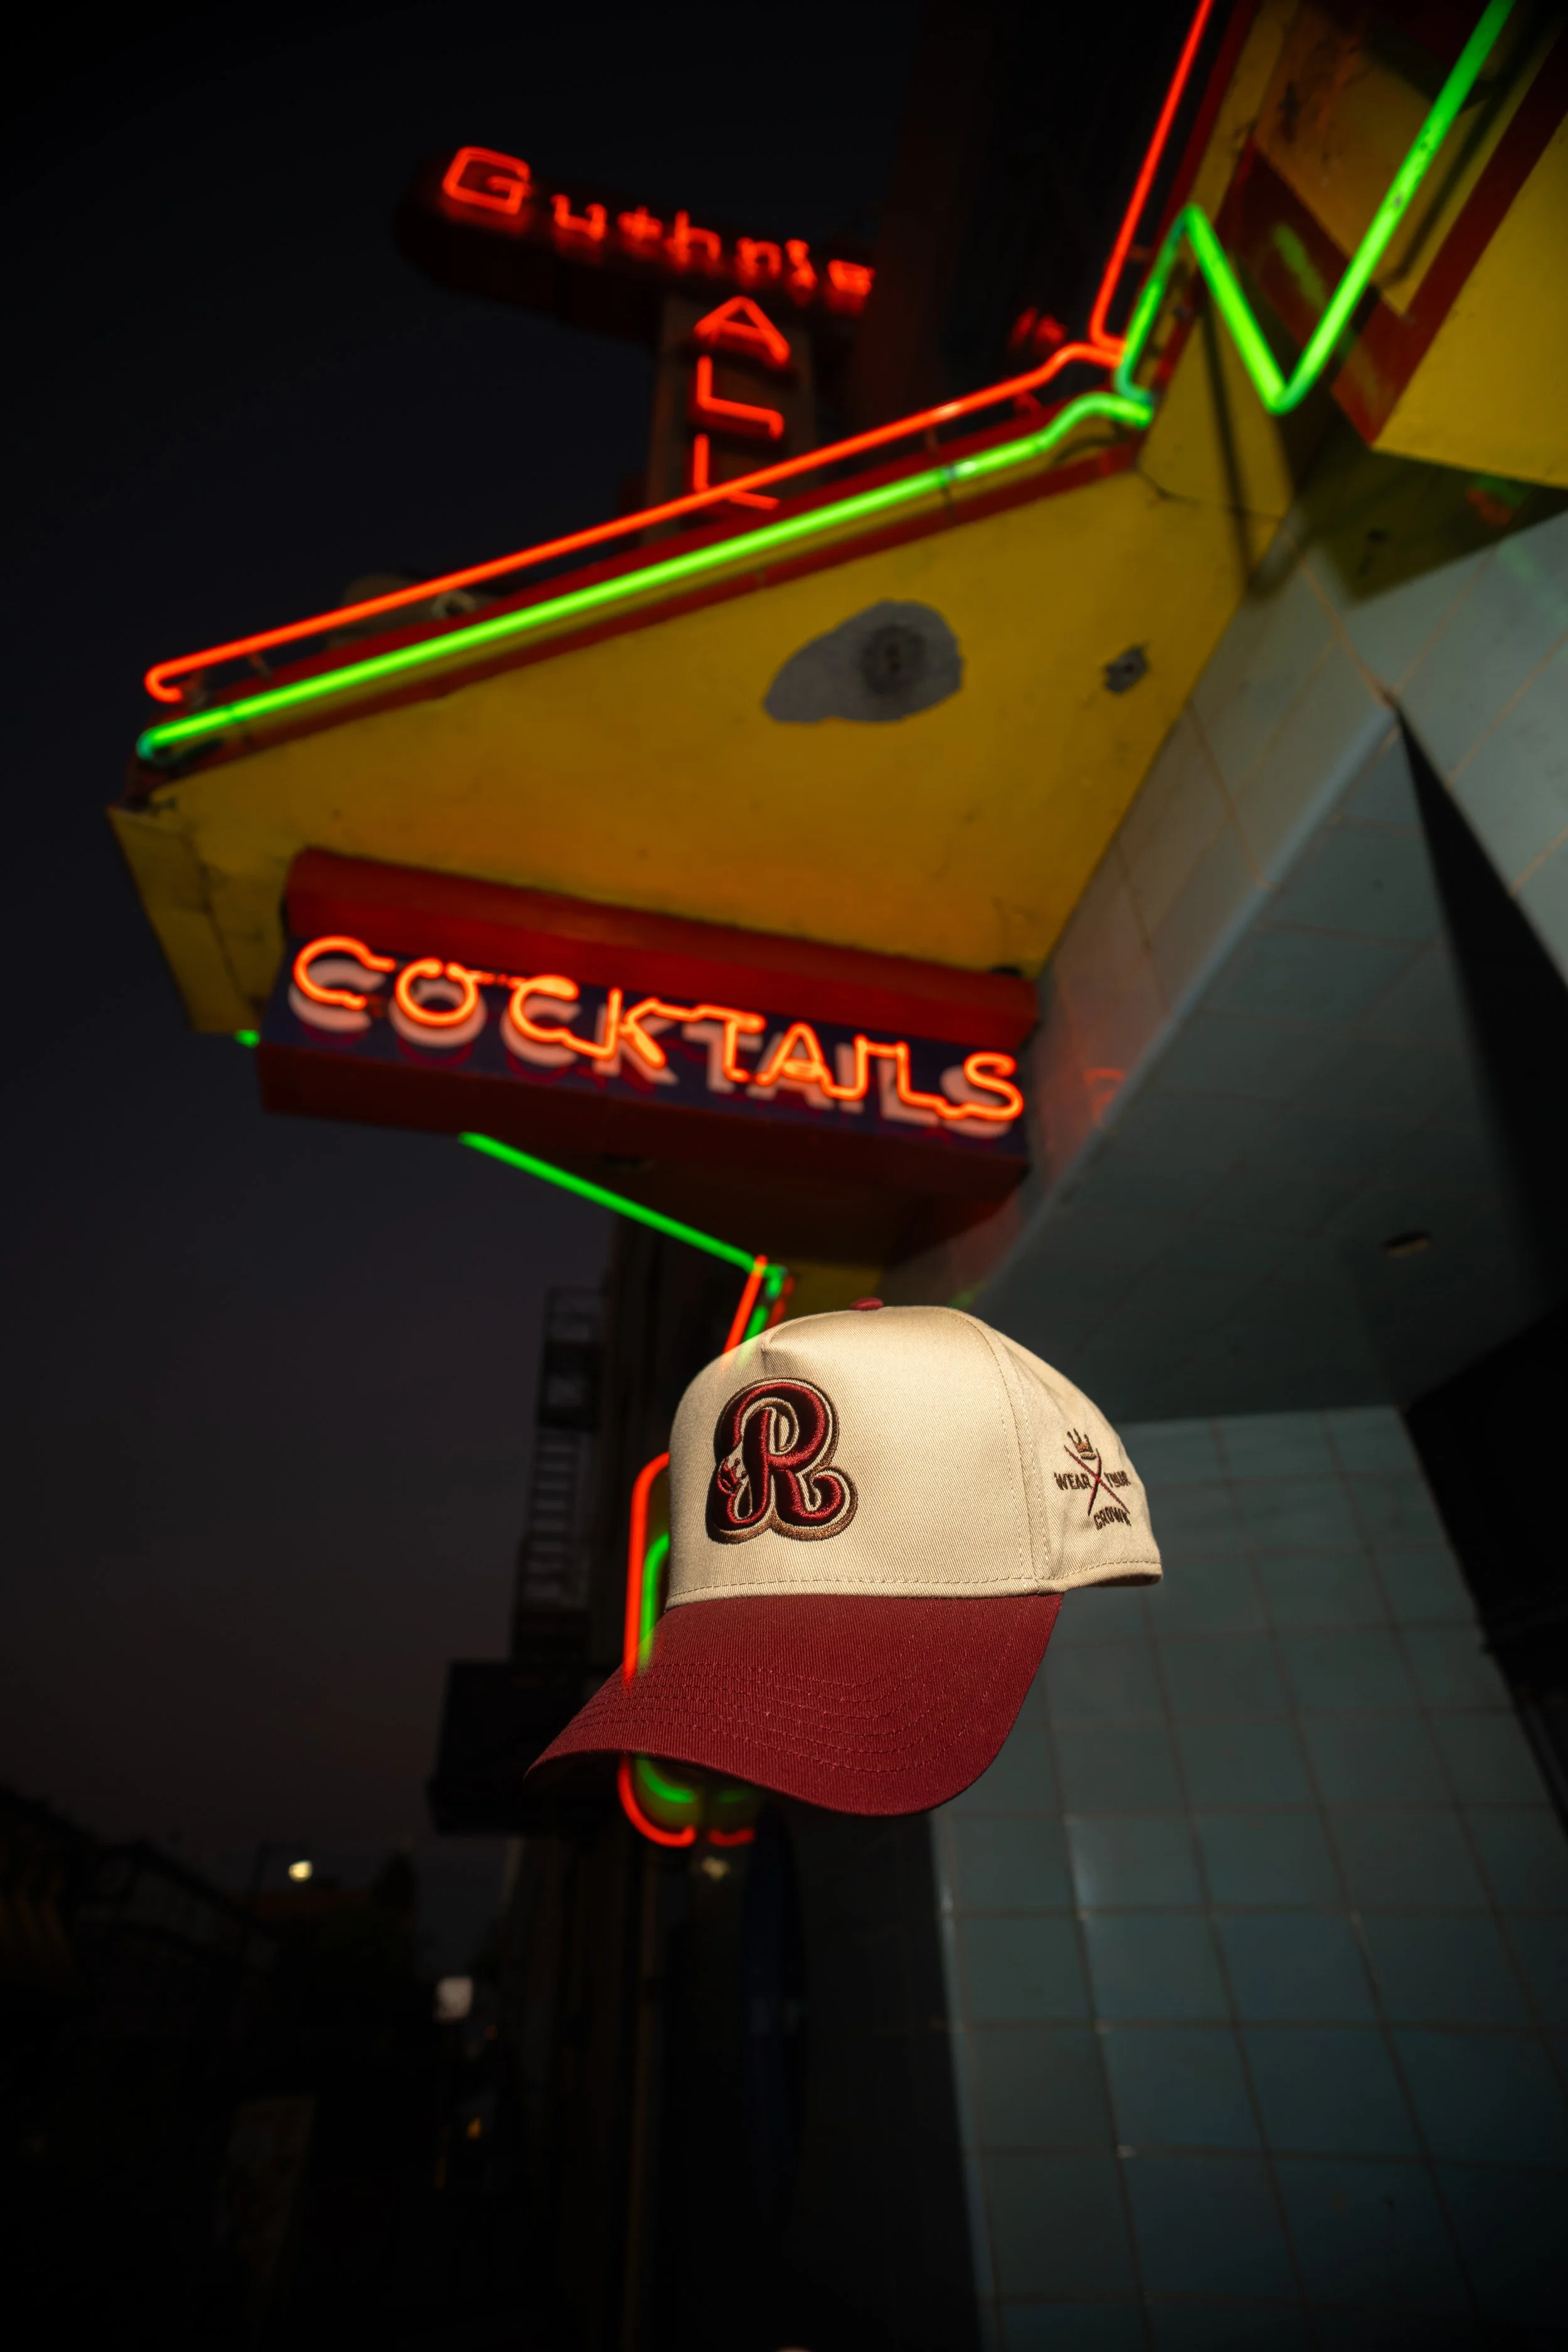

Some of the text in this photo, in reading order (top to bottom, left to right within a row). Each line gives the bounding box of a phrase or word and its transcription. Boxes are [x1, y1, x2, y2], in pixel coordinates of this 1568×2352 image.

[290, 936, 1024, 1136] COCKTAILS
[706, 1375, 858, 1545] R
[1054, 1472, 1093, 1490] WEAR
[1093, 1506, 1131, 1530] CROWN
